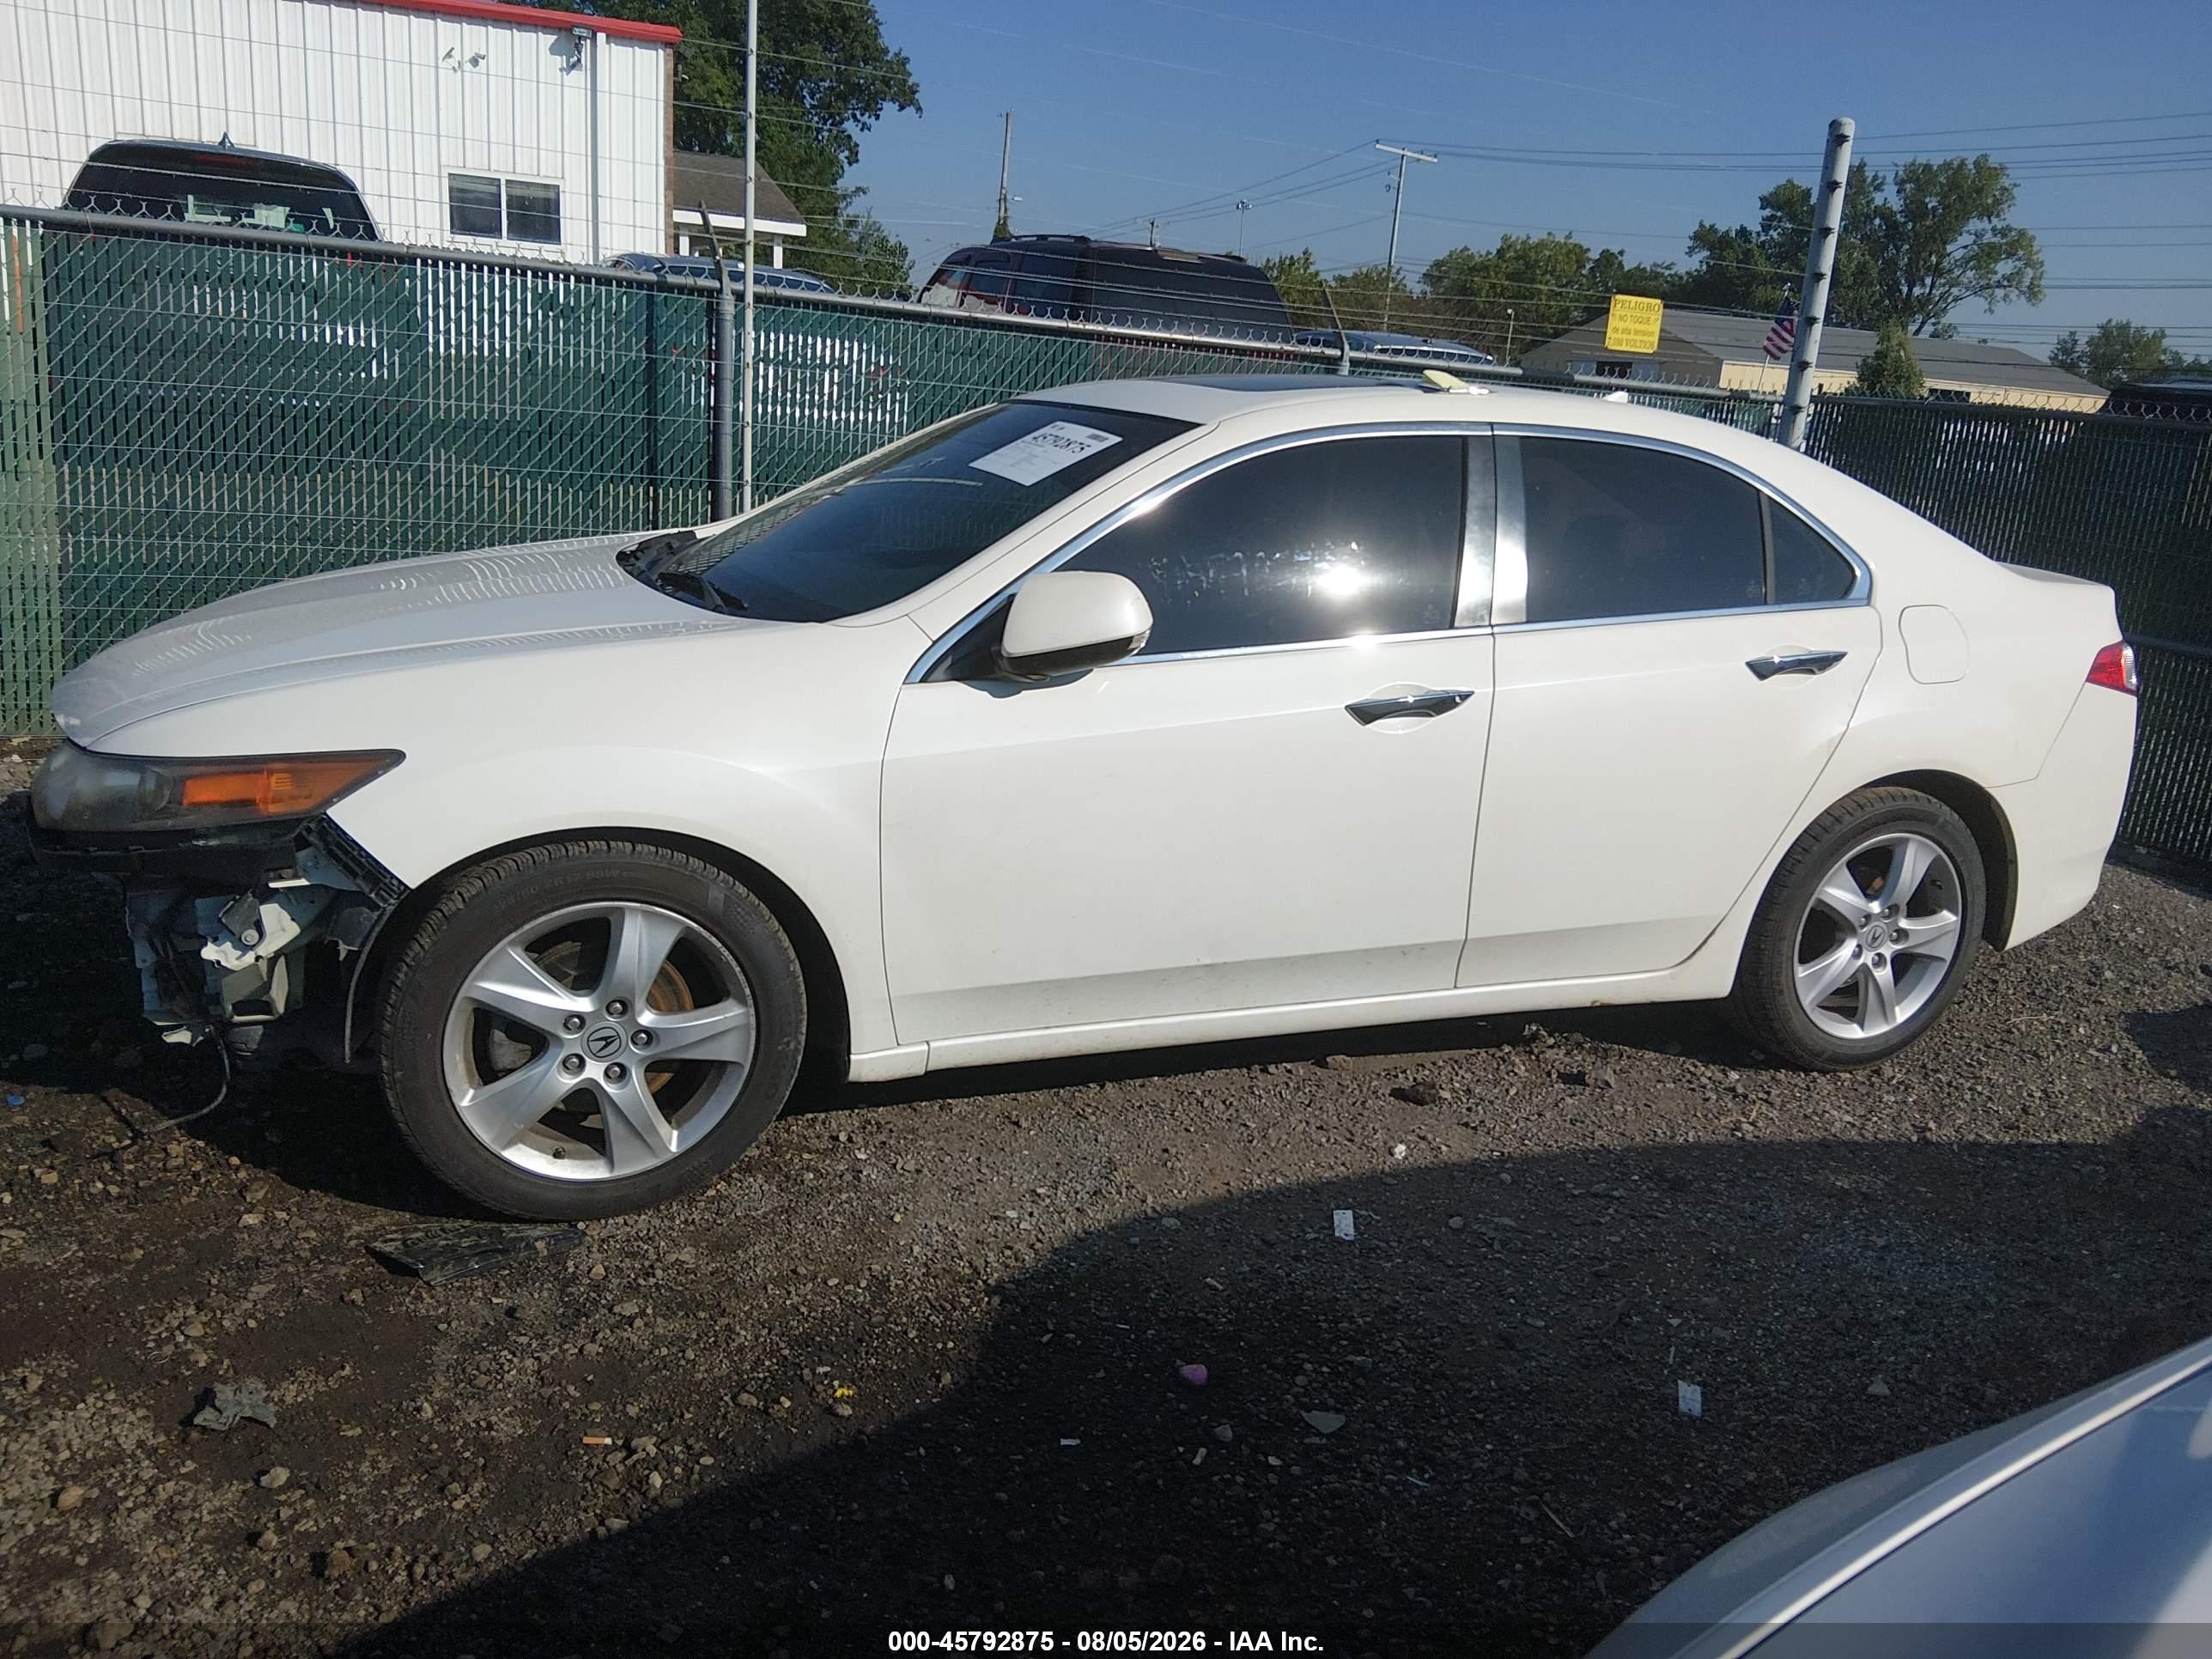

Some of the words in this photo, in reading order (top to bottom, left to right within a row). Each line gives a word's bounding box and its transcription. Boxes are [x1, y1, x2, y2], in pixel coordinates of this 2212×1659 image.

[1613, 299, 1661, 313] PELIGRO
[1619, 313, 1628, 324] NO
[1629, 314, 1652, 325] TOQUE
